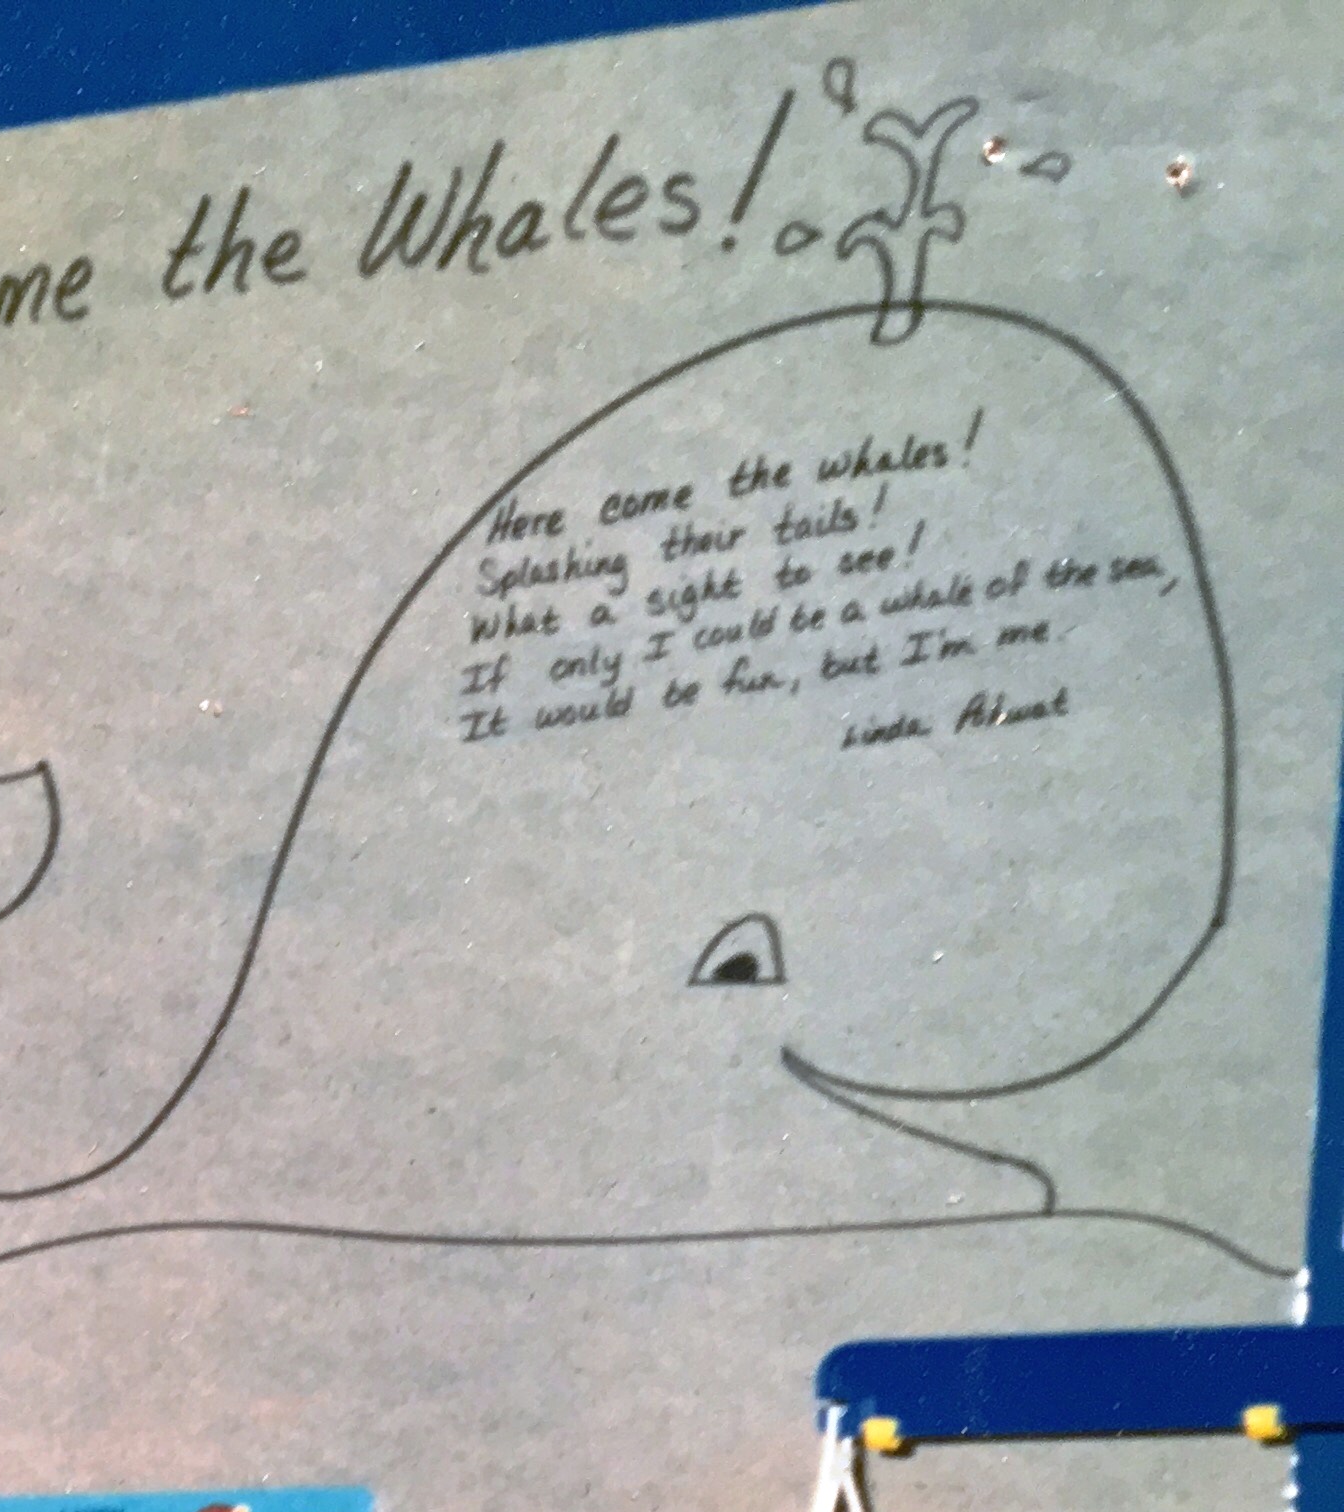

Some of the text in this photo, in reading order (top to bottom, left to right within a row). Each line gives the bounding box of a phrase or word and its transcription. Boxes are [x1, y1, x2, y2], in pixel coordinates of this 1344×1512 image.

[162, 184, 307, 299] the
[358, 88, 798, 280] Whales!
[475, 480, 889, 601] Splashing their tails!
[487, 406, 985, 545] Here come the whales!
[461, 652, 510, 696] If
[548, 645, 624, 688] only
[642, 629, 675, 663] I
[693, 604, 780, 651] could
[789, 603, 826, 634] be
[840, 599, 867, 625] a
[879, 572, 974, 616] whale
[984, 557, 1032, 601] of
[1043, 556, 1099, 590] the
[470, 517, 926, 645] What a sight to see!
[461, 705, 510, 744] It
[535, 684, 636, 730] would
[661, 678, 703, 709] be
[721, 654, 800, 696] fun,
[820, 642, 881, 682] but
[899, 628, 979, 667] I'm
